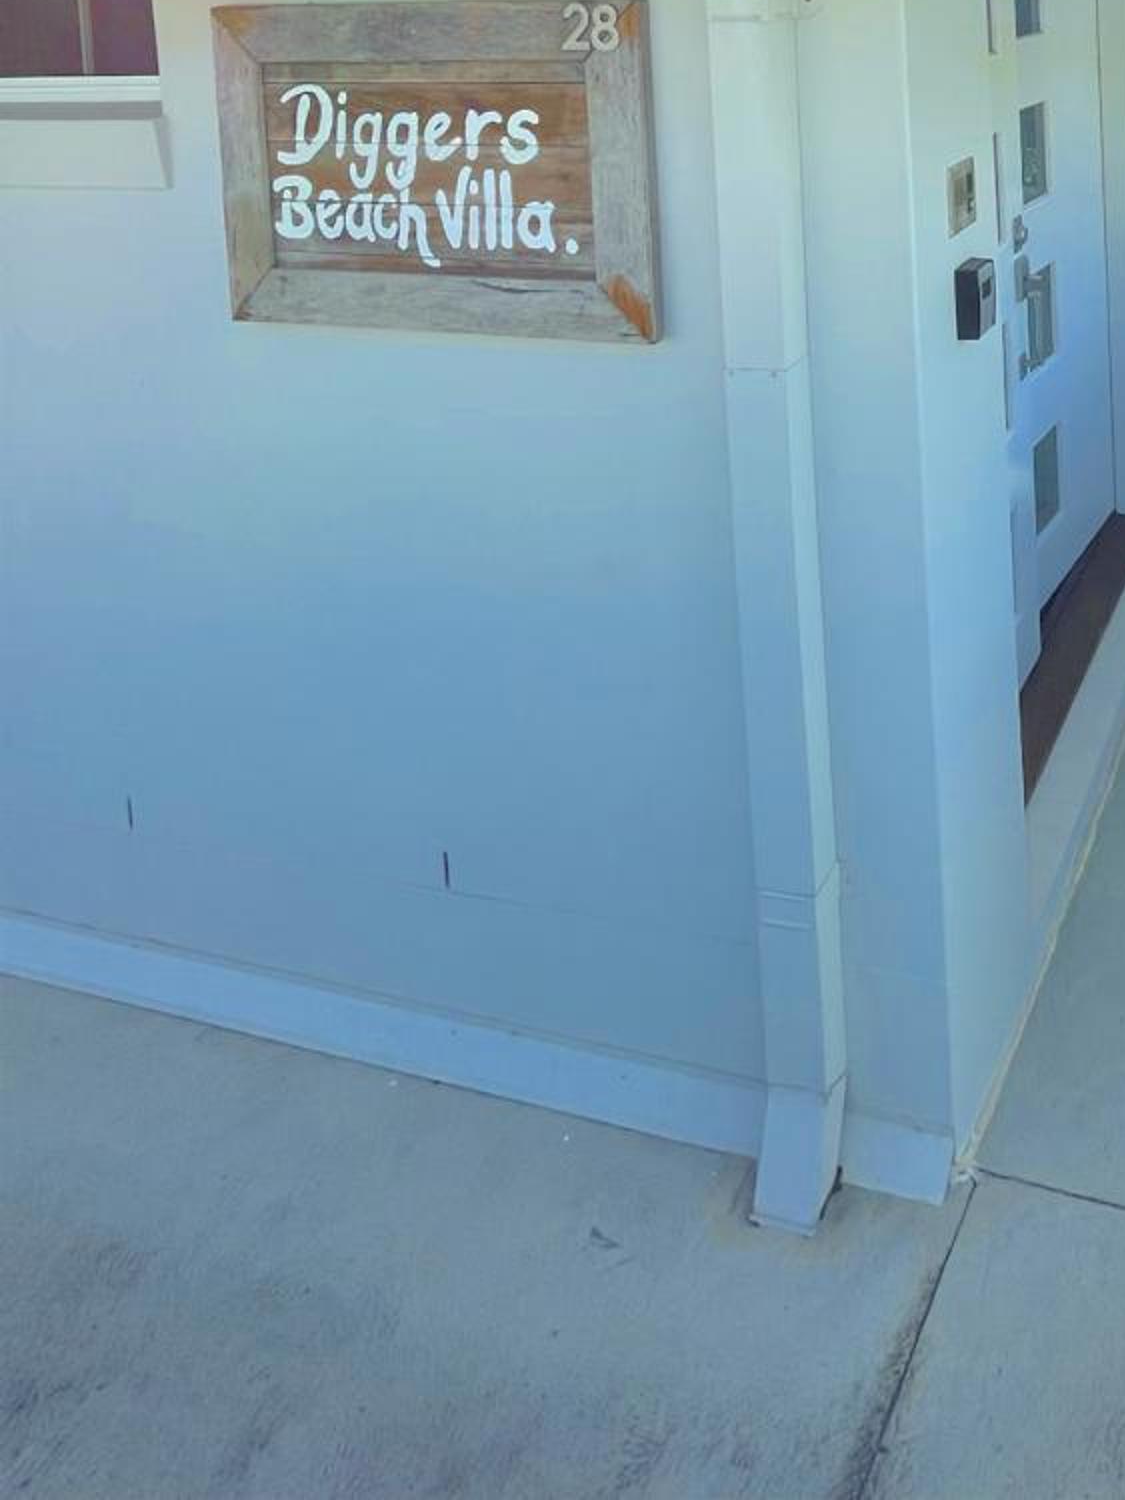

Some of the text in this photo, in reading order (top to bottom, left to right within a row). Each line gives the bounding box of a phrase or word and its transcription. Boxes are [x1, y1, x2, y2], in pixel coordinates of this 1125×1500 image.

[561, 2, 620, 52] 28
[277, 83, 540, 189] Diggers
[273, 165, 579, 268] Beach Villa.
